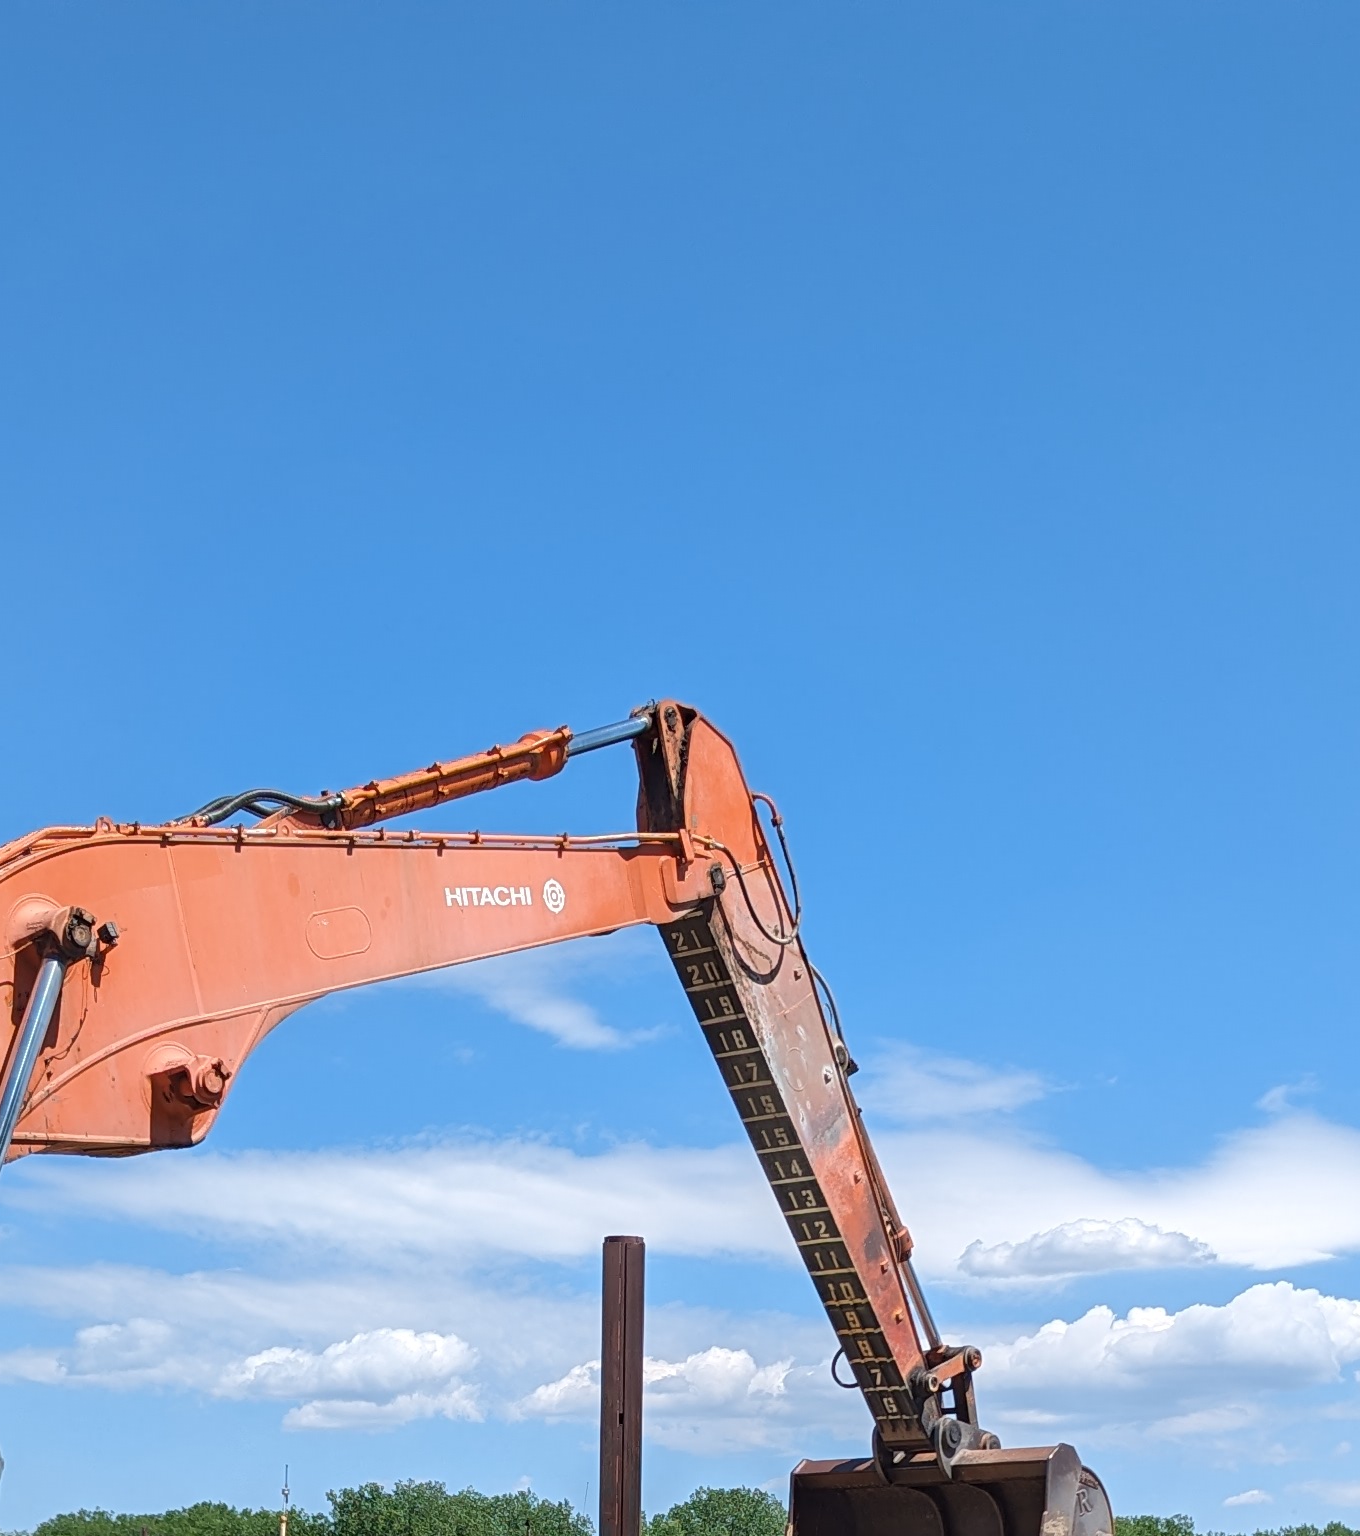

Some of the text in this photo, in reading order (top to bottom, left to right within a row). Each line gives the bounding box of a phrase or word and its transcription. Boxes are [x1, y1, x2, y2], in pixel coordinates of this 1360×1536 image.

[444, 886, 533, 907] HITACHI
[671, 930, 702, 951] 21
[686, 961, 720, 985] 20
[705, 995, 735, 1017] 19
[719, 1029, 747, 1051] 18
[733, 1062, 758, 1083] 17
[748, 1095, 777, 1115] 16
[761, 1127, 790, 1147] 15
[775, 1159, 802, 1179] 14
[788, 1189, 817, 1208] 13
[801, 1221, 830, 1240] 12
[814, 1250, 840, 1270] 11
[828, 1282, 855, 1301] 10
[845, 1311, 861, 1328] 9
[857, 1340, 873, 1357] 8
[870, 1368, 882, 1386] 7
[883, 1397, 898, 1413] 6
